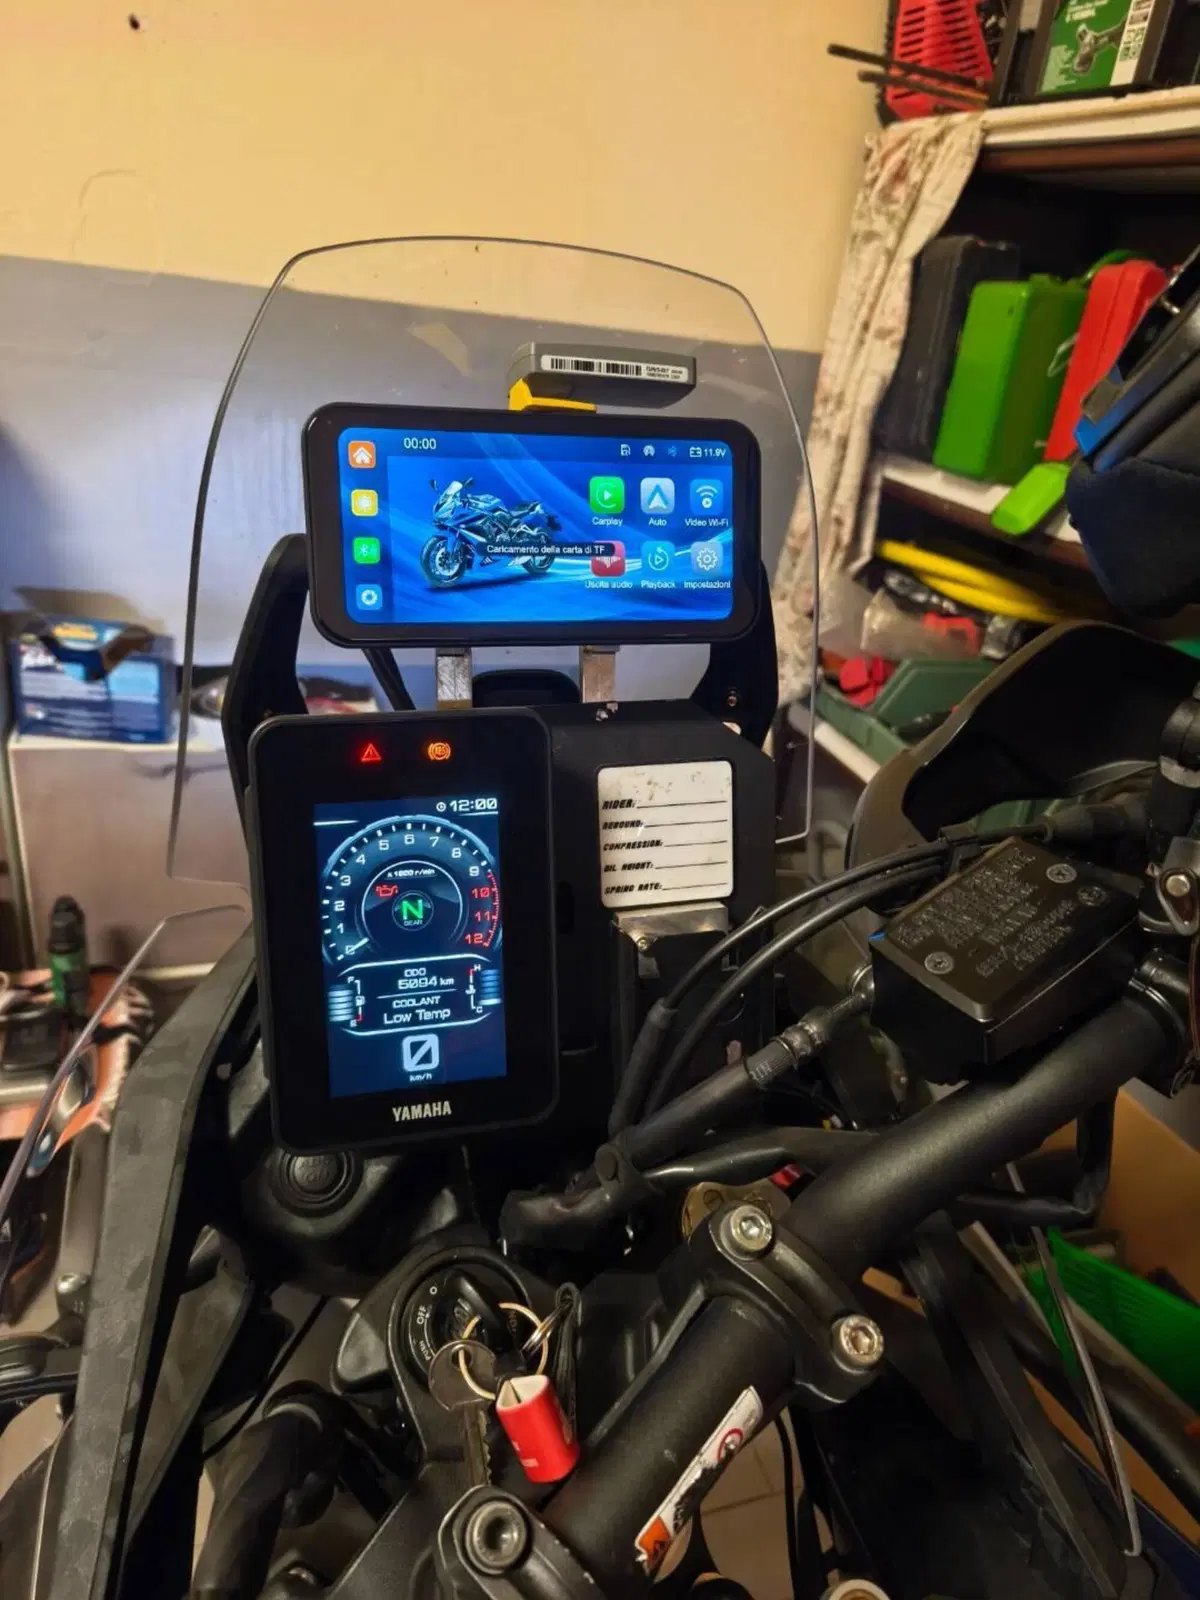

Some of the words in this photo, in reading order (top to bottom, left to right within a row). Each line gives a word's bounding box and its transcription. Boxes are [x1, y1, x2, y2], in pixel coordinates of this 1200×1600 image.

[404, 438, 437, 450] 00:00
[592, 517, 623, 527] Carplay
[648, 518, 667, 526] Auto
[685, 518, 707, 527] Video
[708, 518, 729, 527] Wi-Fi
[486, 544, 540, 553] Caricamento
[541, 544, 561, 553] della
[562, 546, 583, 554] carta
[584, 545, 592, 554] di
[594, 545, 605, 554] TF
[585, 580, 609, 589] Uscita
[611, 580, 633, 589] audio
[641, 580, 677, 589] Playback
[684, 580, 731, 590] Impostazioni
[450, 797, 498, 812] 12:00
[404, 834, 415, 844] 6
[429, 836, 440, 847] 7
[378, 840, 389, 851] 5
[451, 847, 462, 858] 8
[355, 854, 366, 865] 4
[469, 866, 480, 876] 9
[604, 864, 617, 872] OIL
[340, 875, 351, 886] 3
[472, 887, 490, 898] 10
[604, 885, 634, 894] SPRING
[334, 900, 345, 911] 2
[402, 899, 424, 920] N
[475, 911, 490, 921] 11
[336, 923, 344, 933] 1
[465, 933, 483, 944] 12
[404, 968, 426, 977] ODO
[347, 976, 355, 984] F
[440, 977, 454, 986] km
[392, 996, 441, 1009] COOLANT
[383, 1011, 411, 1024] Low
[416, 1008, 451, 1022] Temp
[402, 1033, 440, 1072] 0
[409, 1072, 432, 1081] km/h
[392, 1100, 452, 1122] YAMAHA
[416, 1304, 428, 1325] OFF
